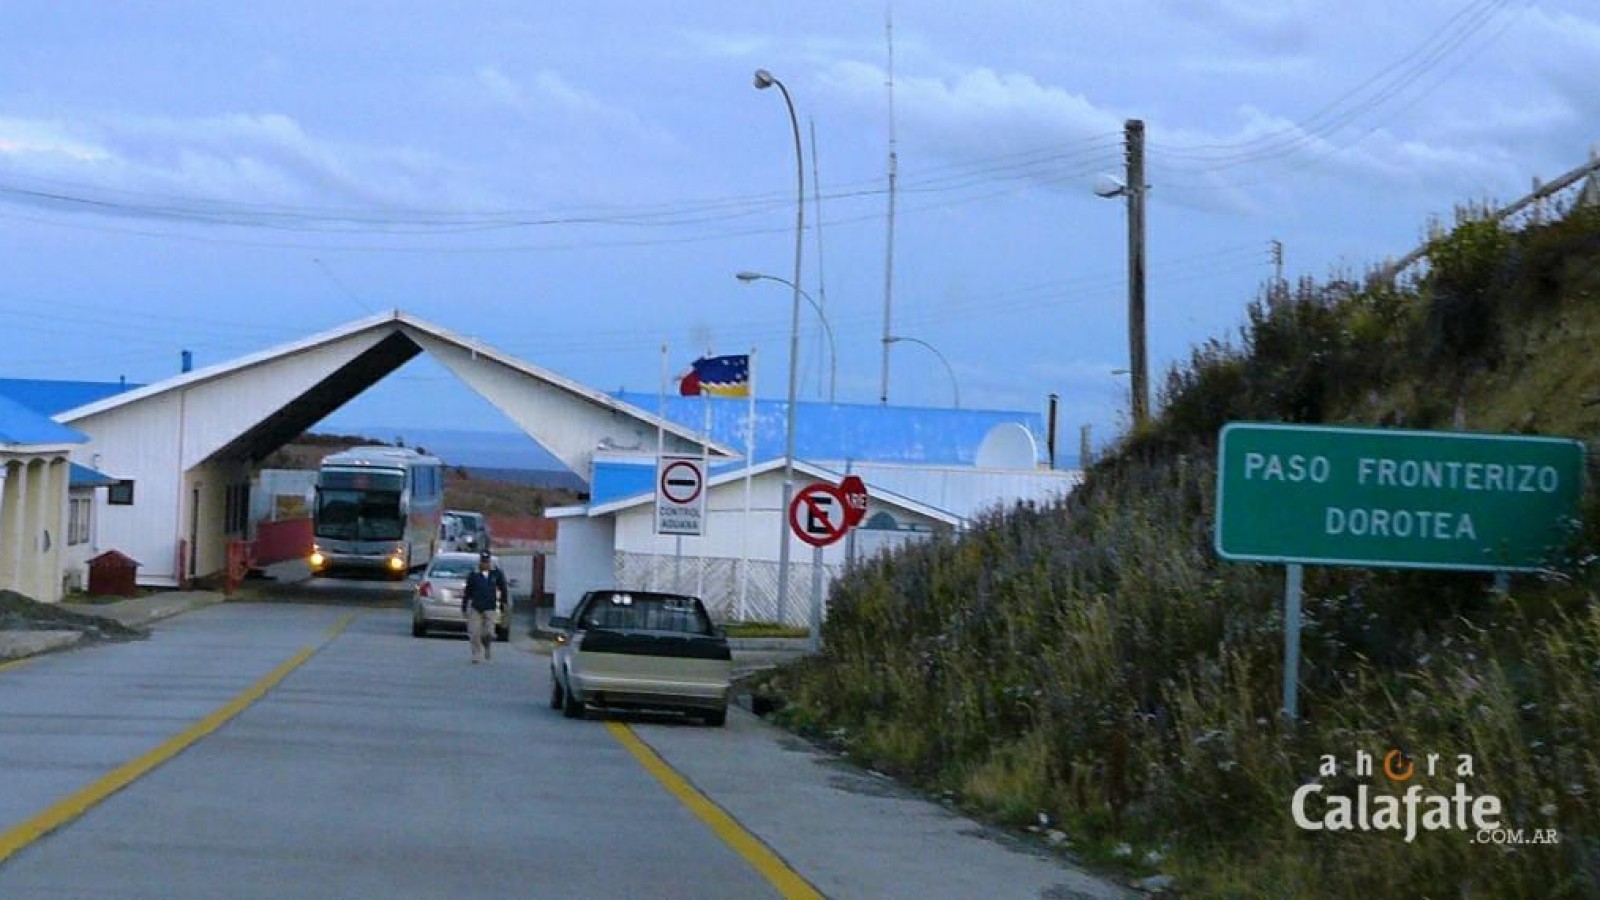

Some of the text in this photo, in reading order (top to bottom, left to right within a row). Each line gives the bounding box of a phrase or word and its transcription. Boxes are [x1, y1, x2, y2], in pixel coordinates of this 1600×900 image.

[1244, 452, 1559, 493] PASO FRONTERIZO
[659, 506, 701, 518] CONTROL
[1325, 506, 1477, 540] DOROTEA
